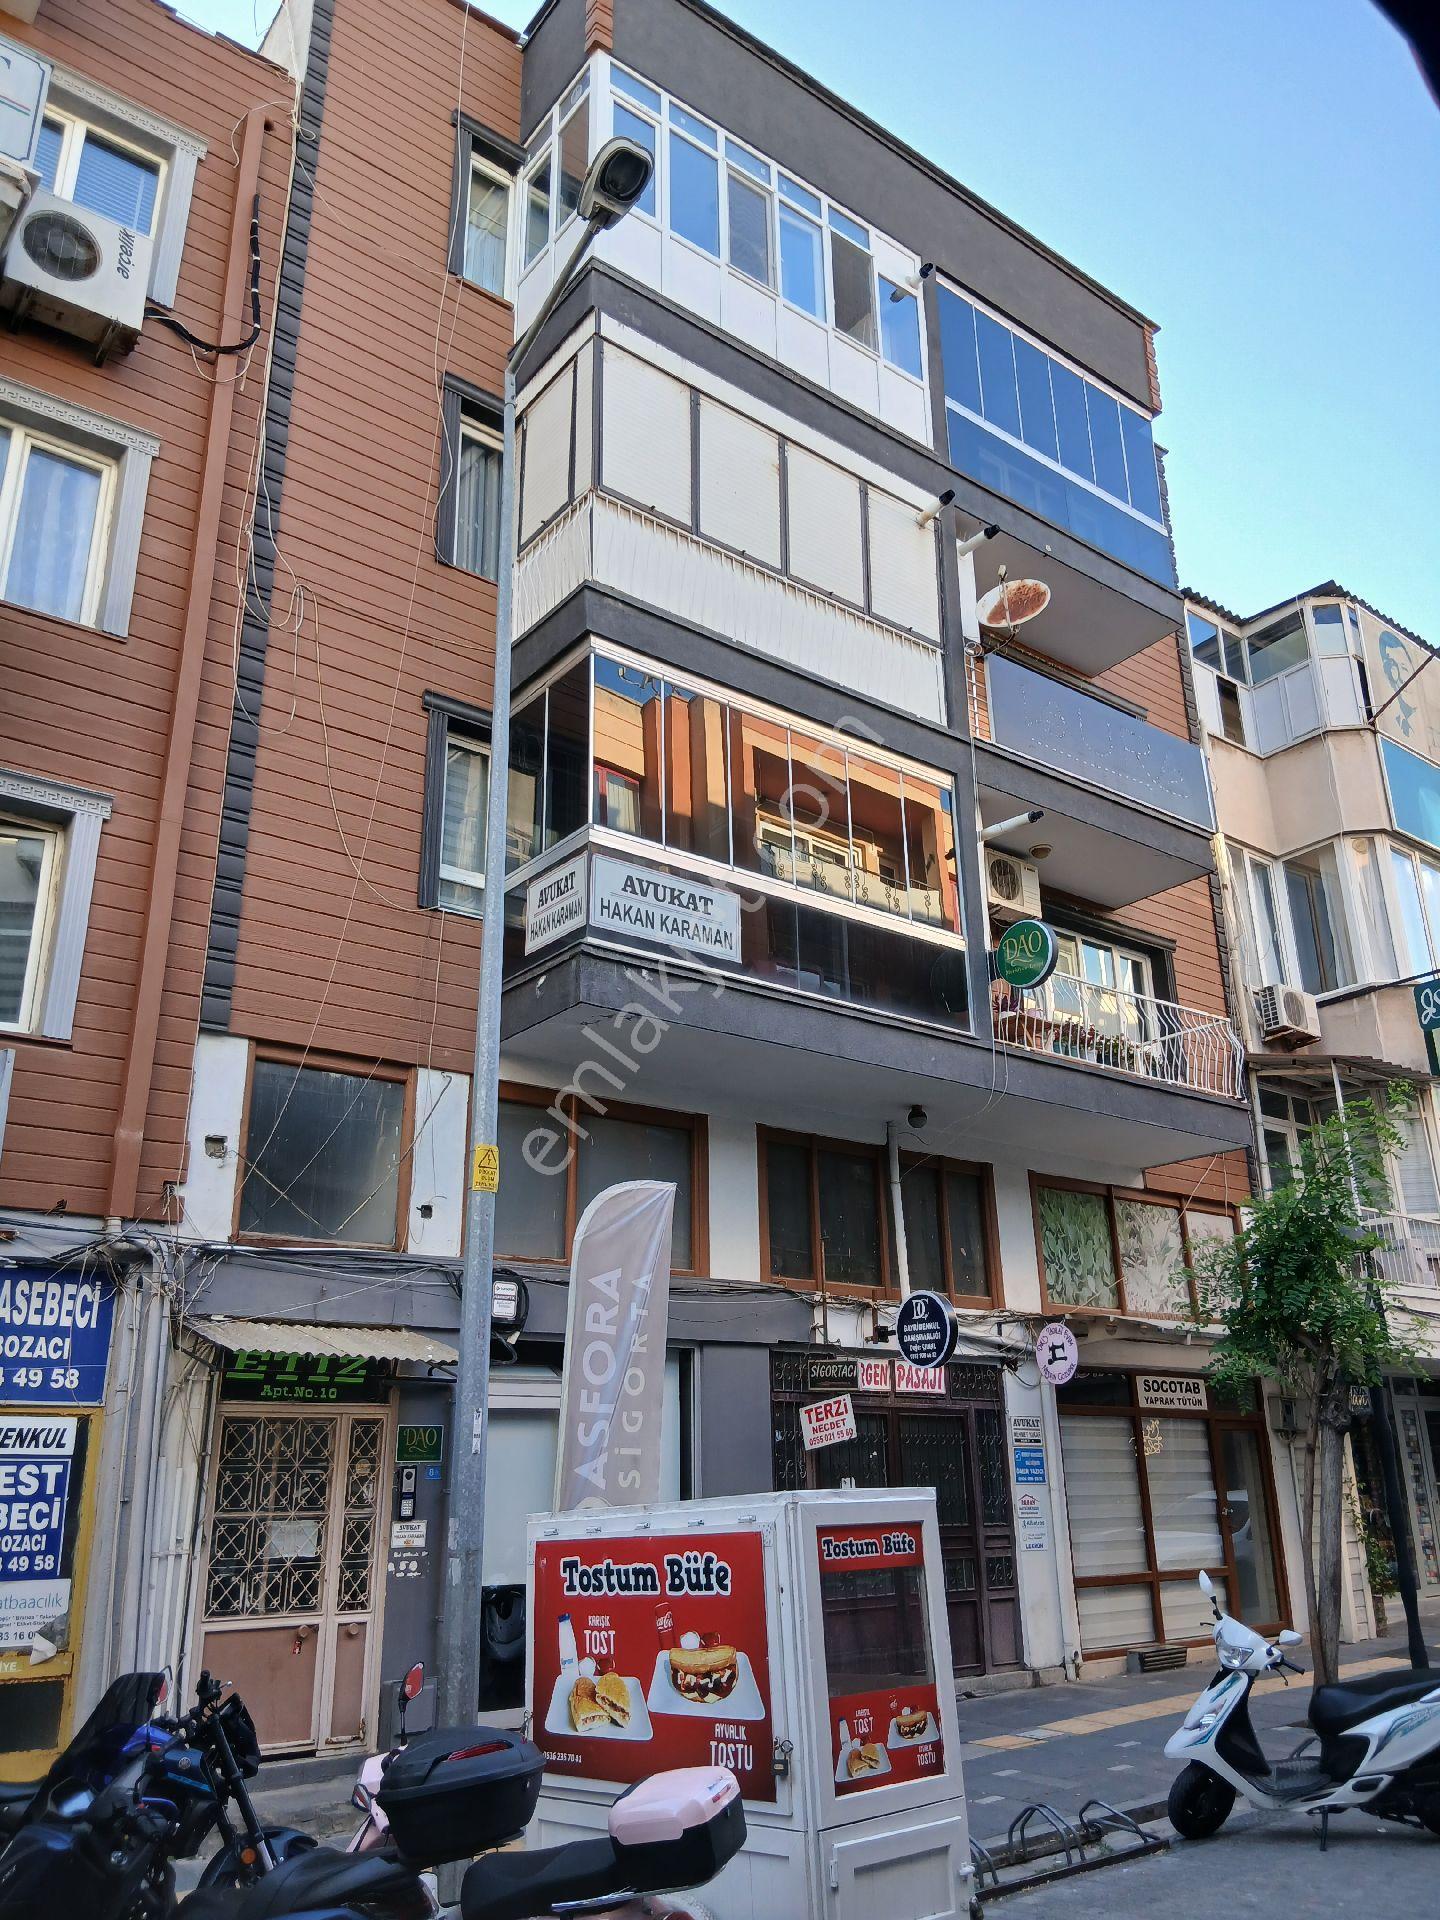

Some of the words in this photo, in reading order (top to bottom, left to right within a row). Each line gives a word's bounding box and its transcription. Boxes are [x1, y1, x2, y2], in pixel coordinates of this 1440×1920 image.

[116, 228, 136, 280] arçelik
[537, 870, 576, 909] AVUKAT
[621, 874, 714, 916] AVUKAT
[529, 914, 551, 942] HAKAN
[551, 896, 583, 930] KARAMAN
[600, 897, 655, 930] HAKAN
[659, 913, 733, 951] KARAMAN
[0, 1335, 71, 1360] OZACI
[12, 1367, 43, 1388] 49
[50, 1368, 80, 1389] 58
[810, 1363, 857, 1378] SİGORTACI
[1143, 1379, 1201, 1394] SOCOTAB
[1144, 1396, 1176, 1406] YAPRAK
[1176, 1397, 1203, 1407] TÜTÜN
[811, 1417, 847, 1435] NECDET
[1013, 1418, 1040, 1428] AVUKAT
[0, 1427, 68, 1449] ENKUL
[404, 1428, 438, 1452] DAO
[809, 1435, 824, 1446] 0555
[824, 1432, 835, 1442] 021
[0, 1464, 64, 1496] EST
[0, 1534, 47, 1553] OZACI
[823, 1537, 880, 1558] Tostum
[882, 1533, 915, 1554] Büfe
[7, 1555, 30, 1572] 49
[34, 1554, 55, 1571] 58
[561, 1557, 660, 1593] Tostum
[665, 1553, 730, 1593] Büfe
[0, 1592, 63, 1610] tbaacılık
[13, 1631, 24, 1641] 16
[583, 1629, 616, 1655] TOST
[714, 1722, 747, 1741] AYVALIK
[853, 1716, 874, 1735] TOST
[709, 1740, 753, 1771] TOSTU
[916, 1751, 936, 1767] TOSTU
